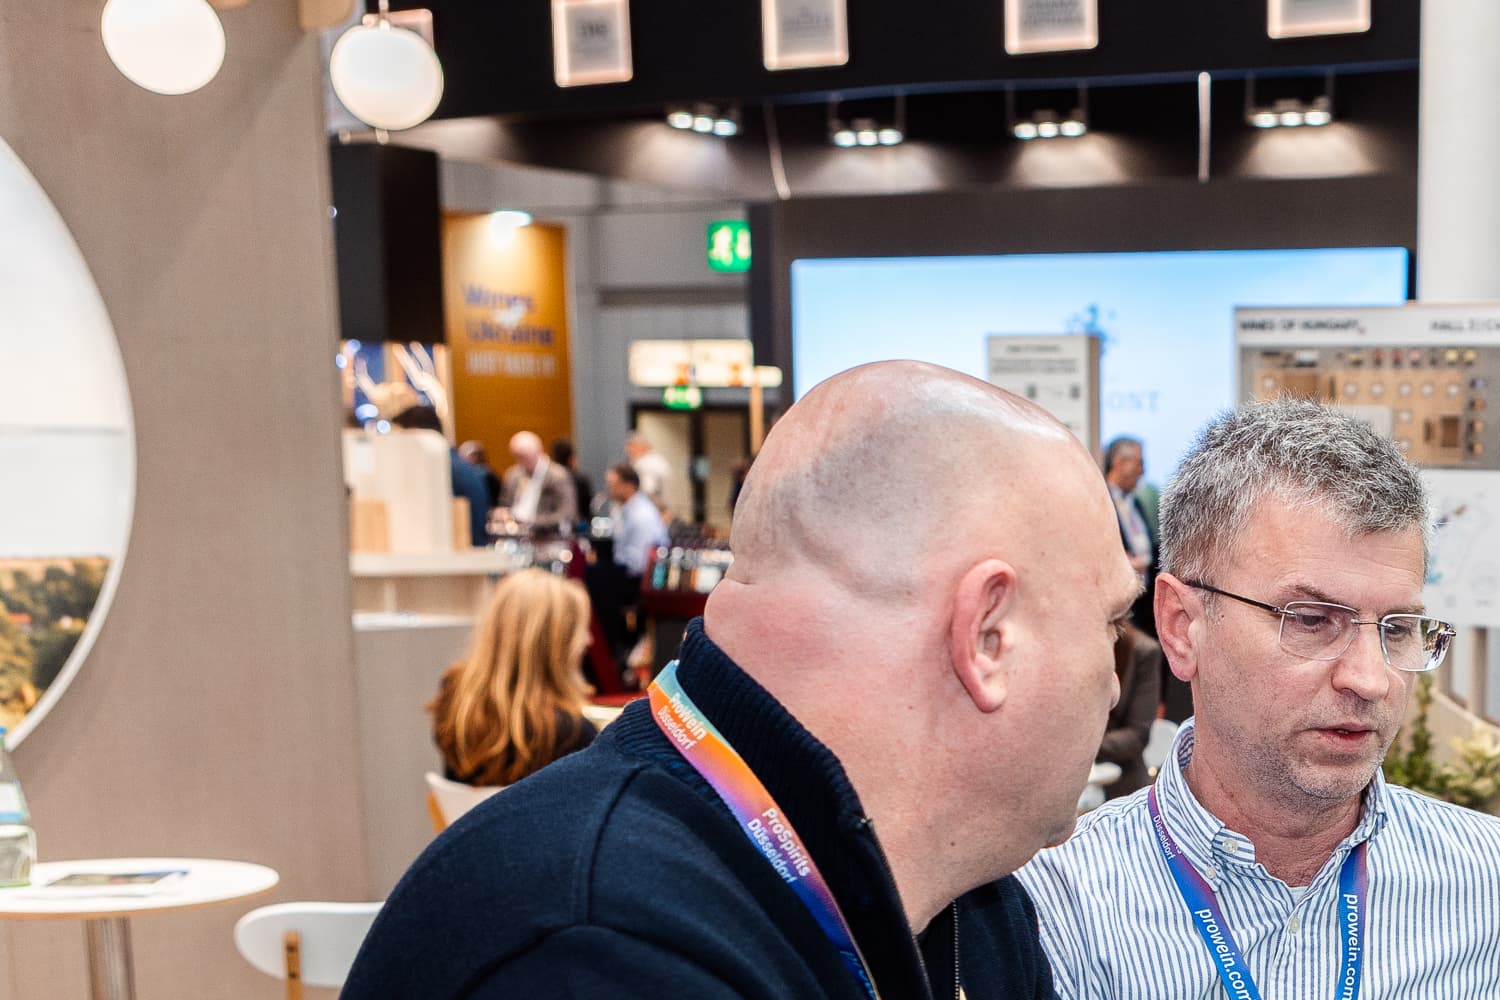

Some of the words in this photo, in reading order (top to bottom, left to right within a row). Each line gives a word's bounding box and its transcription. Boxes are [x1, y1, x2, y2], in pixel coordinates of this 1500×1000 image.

[669, 692, 708, 741] ProWein
[747, 818, 798, 884] Düsseldorf
[762, 807, 812, 878] ProSpirits
[1153, 814, 1176, 862] Düsseldorf
